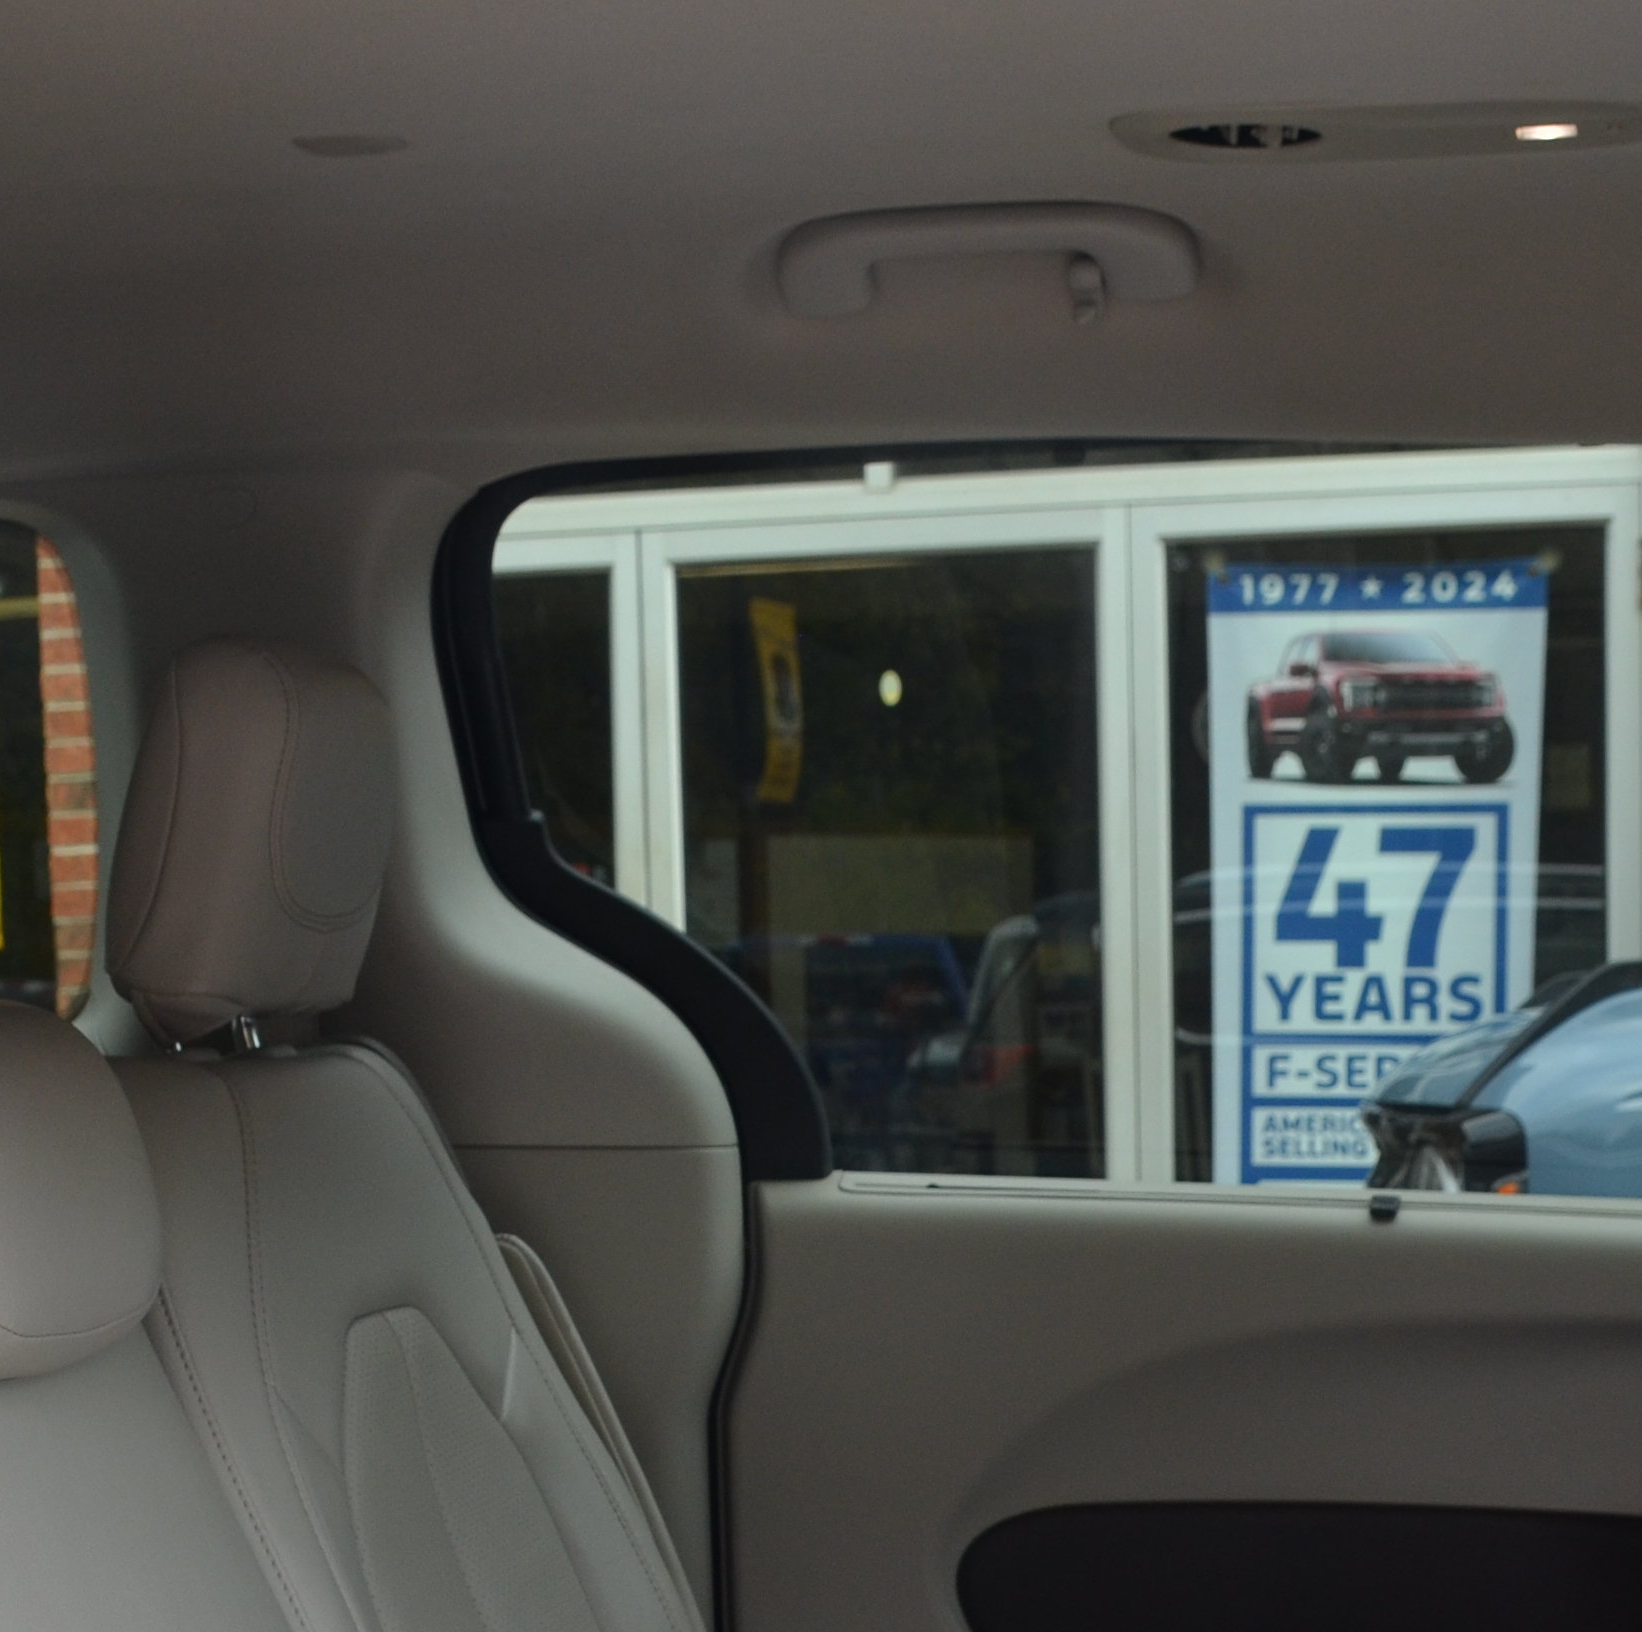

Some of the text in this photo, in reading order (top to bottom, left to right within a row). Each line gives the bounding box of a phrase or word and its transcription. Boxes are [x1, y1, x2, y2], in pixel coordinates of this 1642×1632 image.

[1240, 569, 1519, 606] 1977 2024
[1274, 826, 1478, 969] 47
[1264, 974, 1485, 1024] YEARS
[1264, 1138, 1368, 1157] SELLING
